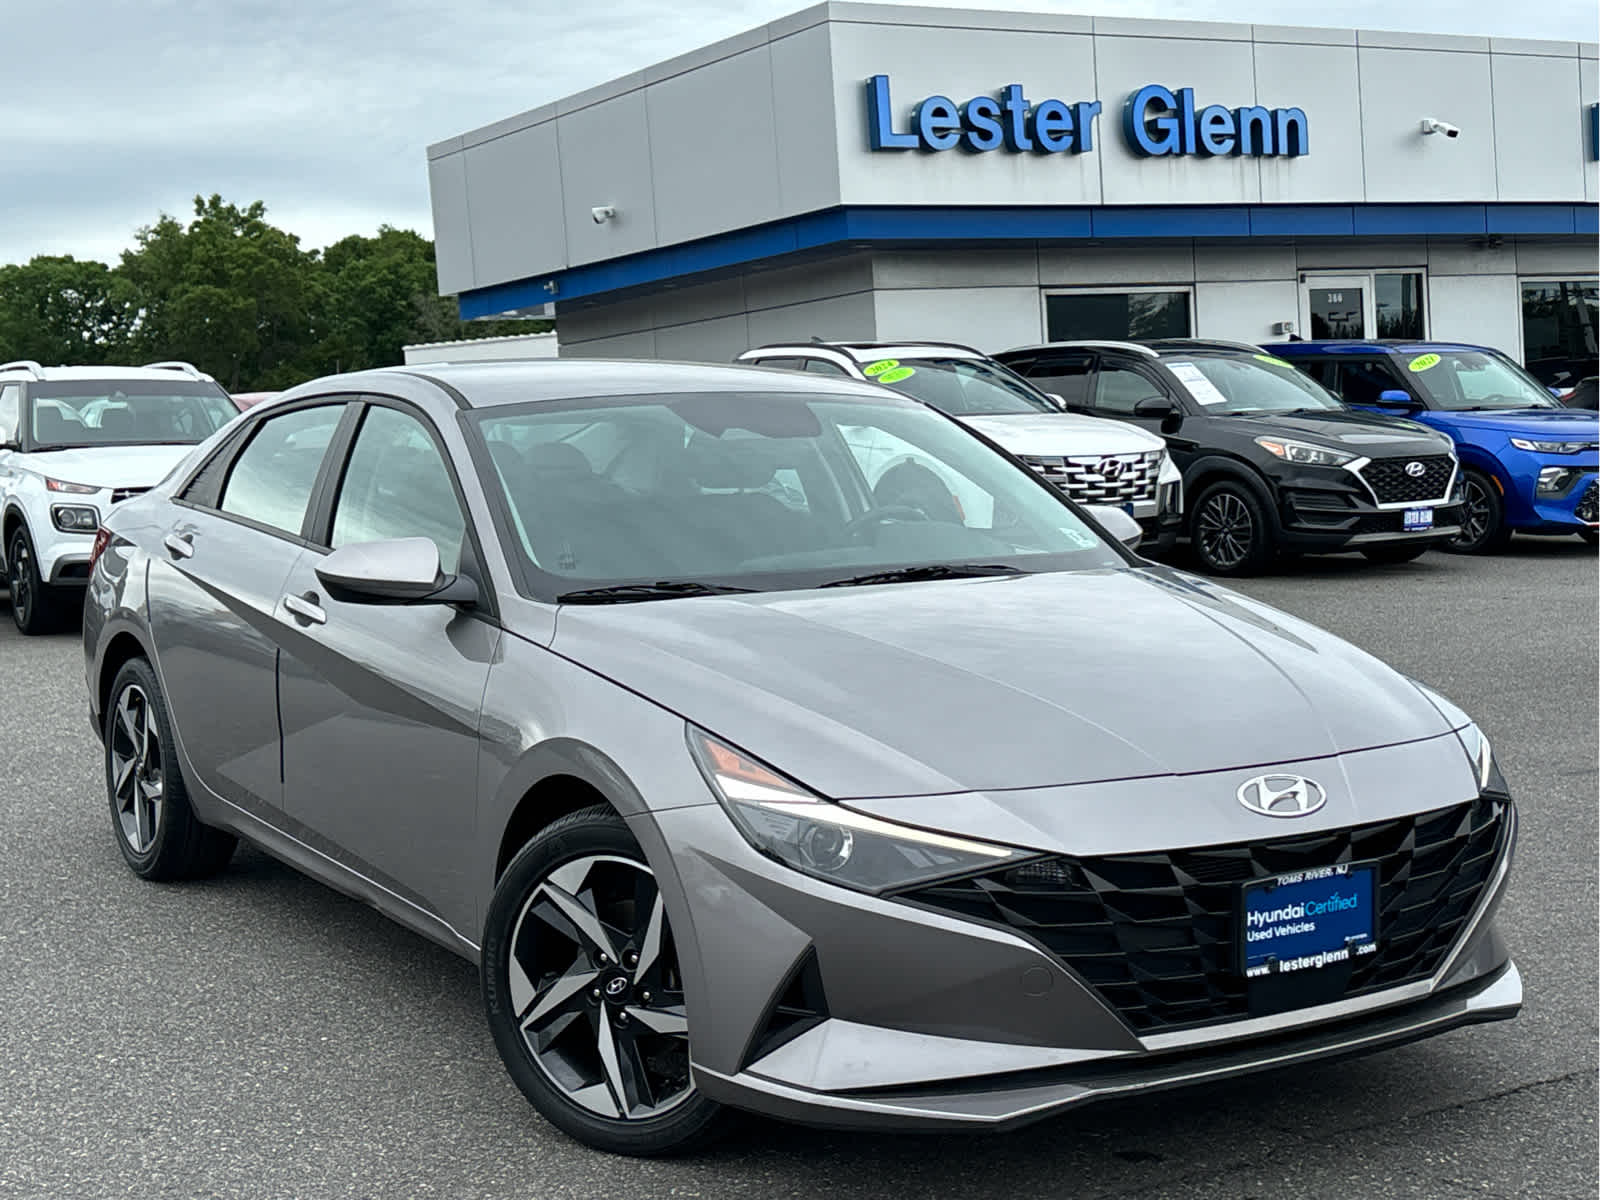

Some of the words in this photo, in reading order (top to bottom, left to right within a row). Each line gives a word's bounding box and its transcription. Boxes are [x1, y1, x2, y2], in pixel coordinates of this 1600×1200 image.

[864, 74, 1101, 154] Lester
[1122, 84, 1309, 157] Glenn
[1277, 875, 1303, 886] TOMS
[1335, 864, 1349, 875] NJ
[1247, 903, 1305, 927] Hyundai
[1305, 893, 1357, 916] Certified
[1247, 928, 1273, 942] Used
[1274, 922, 1316, 936] Vehicles
[1246, 966, 1270, 977] www.
[1279, 949, 1349, 972] lesterglenn
[1356, 943, 1377, 956] .com
